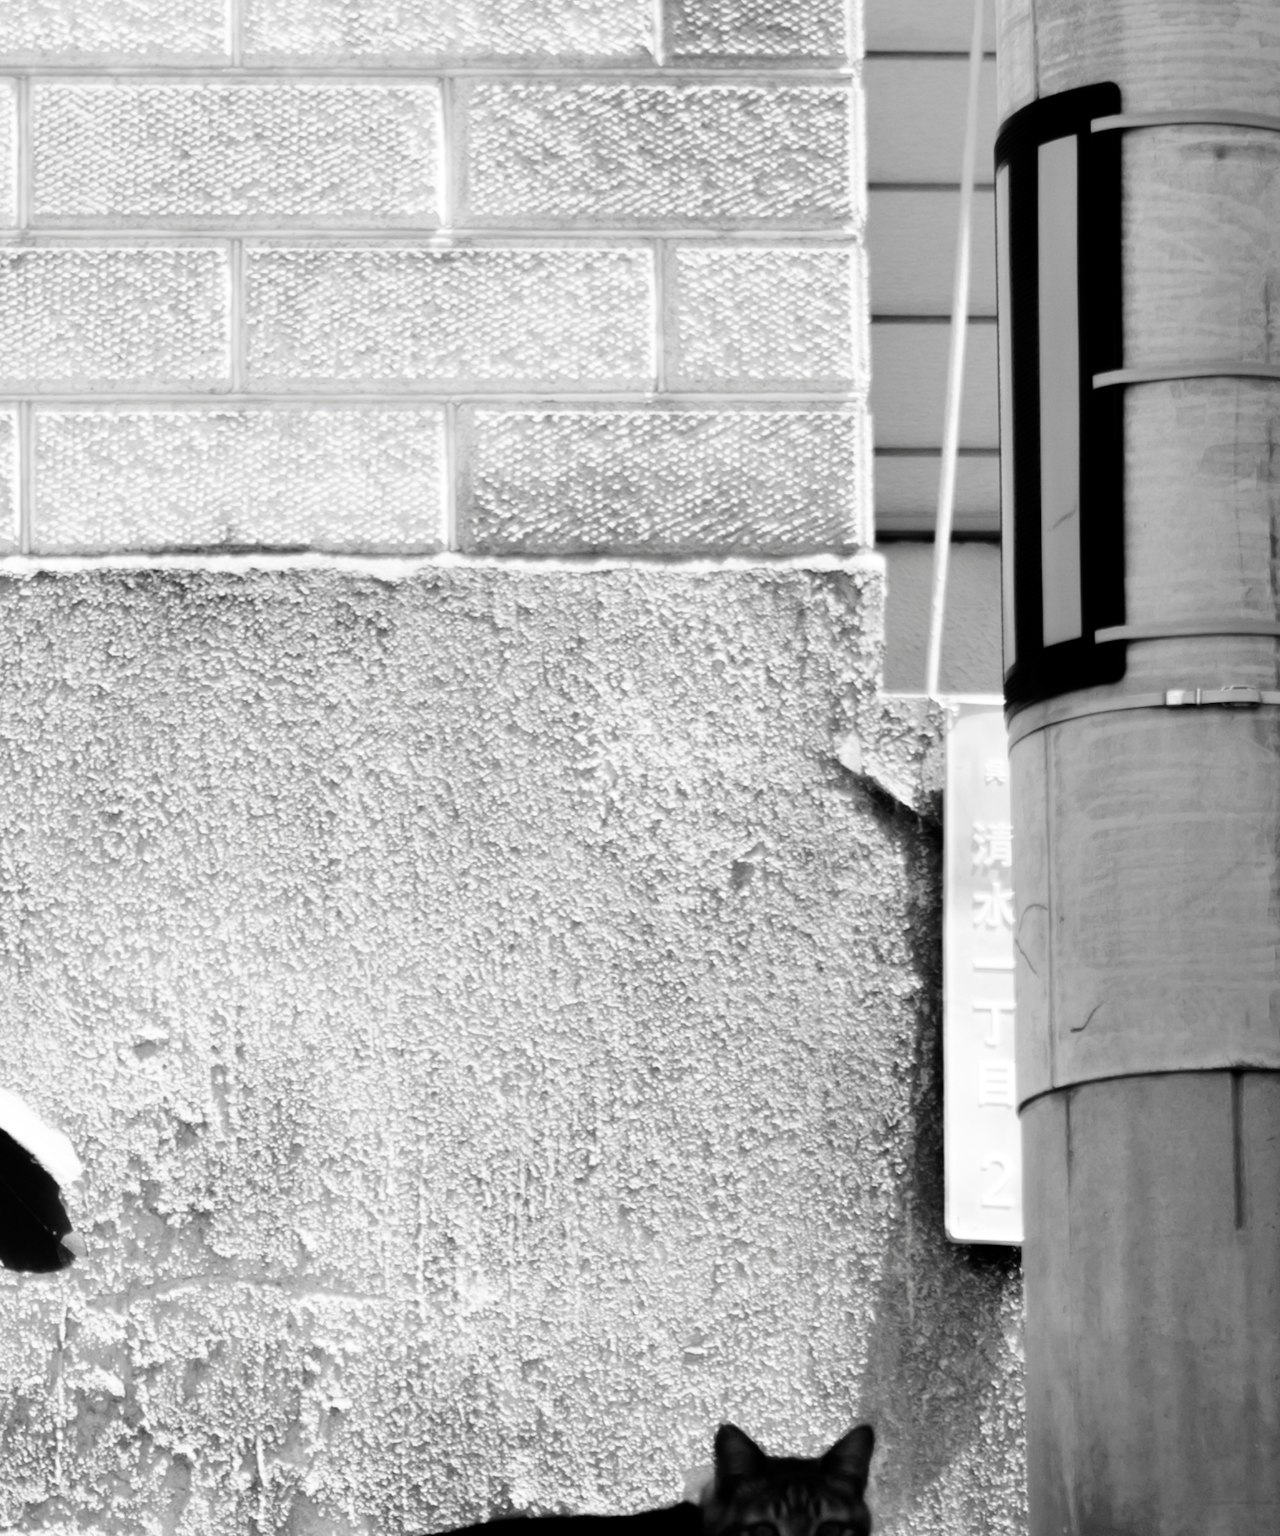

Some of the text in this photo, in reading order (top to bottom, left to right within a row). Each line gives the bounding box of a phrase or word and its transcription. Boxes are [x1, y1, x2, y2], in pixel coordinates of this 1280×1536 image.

[972, 820, 1016, 1208] 清水一丁目 2
